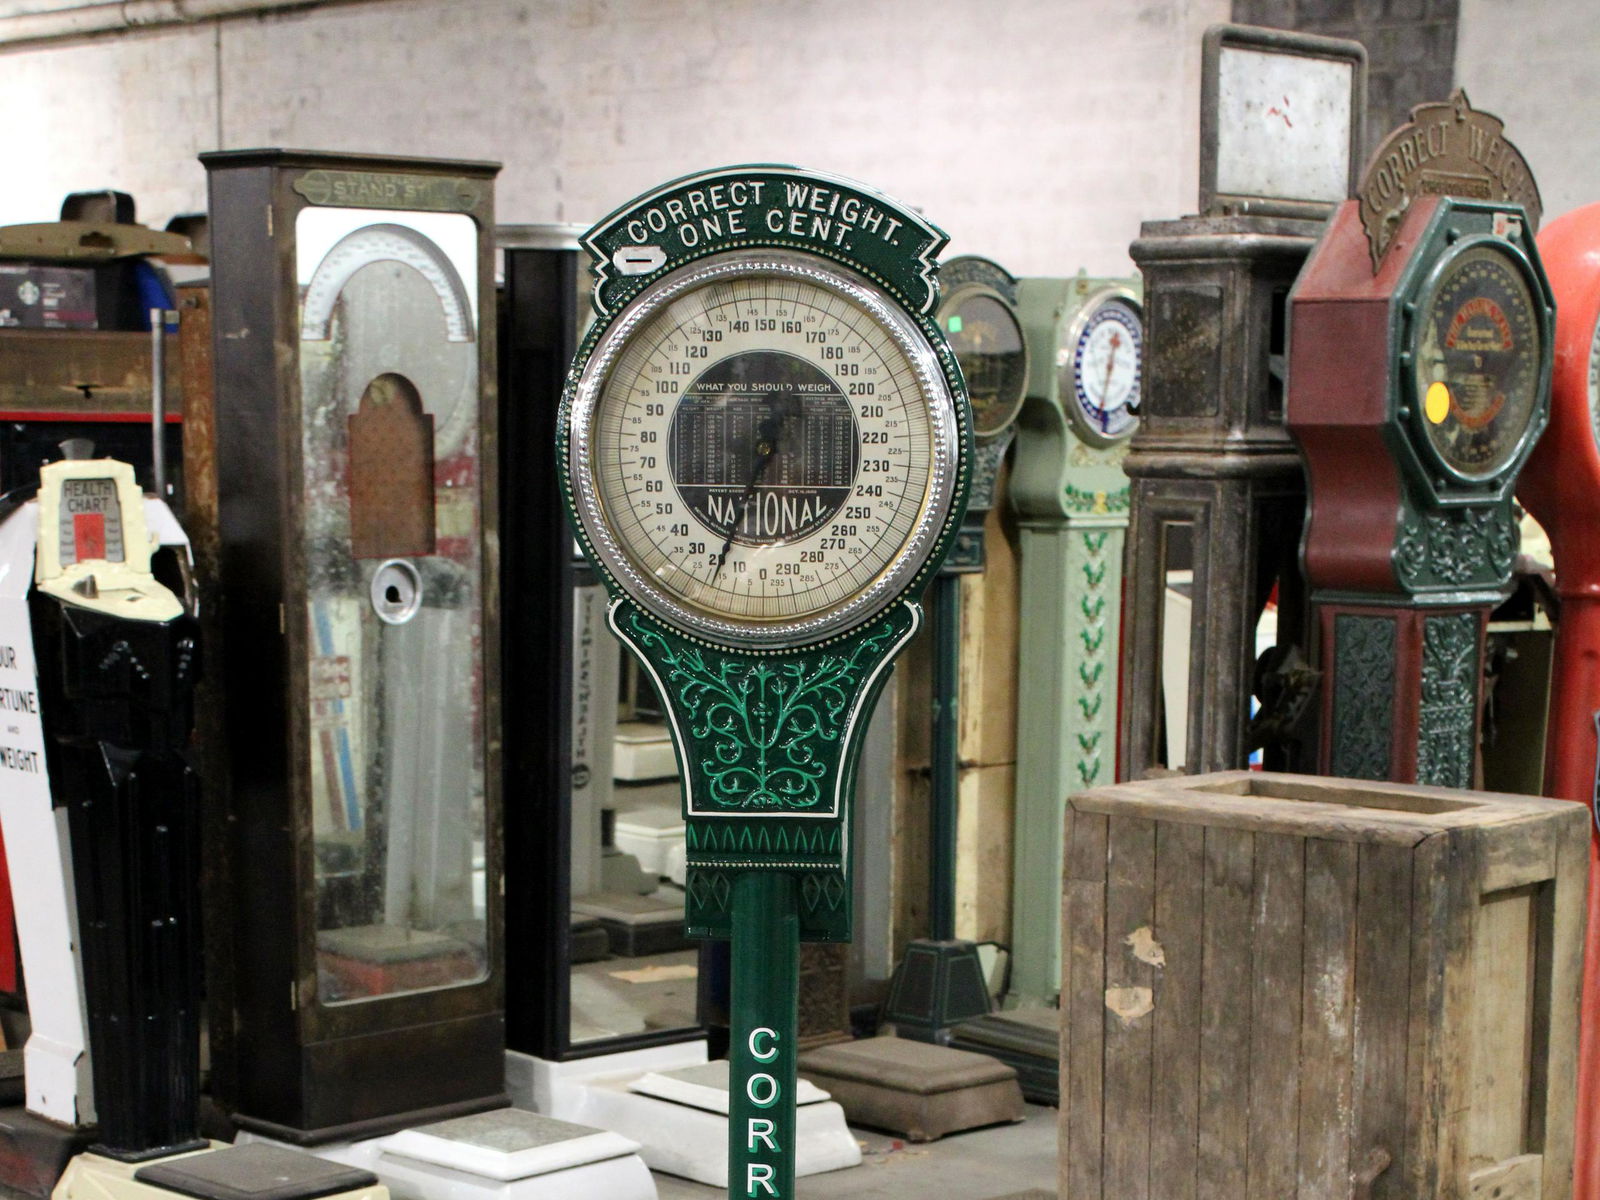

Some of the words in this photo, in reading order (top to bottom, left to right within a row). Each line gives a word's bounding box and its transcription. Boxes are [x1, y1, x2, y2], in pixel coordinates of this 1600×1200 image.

[1368, 121, 1449, 213] CORRECT
[333, 181, 397, 198] STAND
[627, 181, 765, 244] CORRECT
[786, 181, 902, 246] WEIGHT.
[680, 210, 747, 248] ONE
[766, 210, 853, 251] CENT.
[715, 314, 727, 323] 135
[776, 309, 788, 317] 155
[803, 315, 816, 323] 165
[728, 320, 750, 334] 140
[754, 318, 776, 331] 150
[781, 320, 802, 334] 160
[690, 327, 702, 335] 125
[702, 330, 723, 343] 130
[805, 331, 827, 343] 170
[827, 328, 840, 336] 175
[668, 344, 678, 352] 115
[685, 345, 707, 359] 120
[820, 346, 843, 359] 180
[848, 346, 861, 354] 185
[651, 365, 663, 373] 105
[669, 362, 691, 375] 110
[834, 363, 859, 376] 190
[864, 367, 877, 375] 195
[656, 380, 678, 394] 100
[697, 383, 724, 392] WHAT
[727, 383, 747, 392] YOU
[797, 383, 832, 392] WEIGH
[849, 383, 874, 396] 200
[646, 404, 664, 416] 90
[861, 405, 883, 418] 210
[885, 420, 898, 428] 215
[641, 431, 657, 443] 80
[862, 432, 888, 444] 220
[888, 447, 902, 455] 225
[640, 457, 656, 469] 70
[863, 460, 889, 472] 230
[633, 473, 643, 481] 65
[63, 481, 113, 498] HEALTH
[645, 481, 663, 493] 60
[856, 484, 882, 497] 240
[67, 497, 109, 512] CHART
[641, 500, 651, 508] 55
[656, 503, 673, 515] 50
[878, 500, 894, 508] 245
[708, 492, 827, 536] NATIONAL
[845, 507, 871, 520] 250
[670, 524, 688, 536] 40
[831, 525, 857, 537] 260
[866, 525, 880, 533] 255
[689, 542, 705, 554] 30
[821, 538, 846, 550] 270
[800, 551, 824, 563] 280
[733, 561, 746, 573] 10
[776, 563, 800, 575] 290
[824, 562, 839, 570] 275
[759, 568, 767, 580] 0
[800, 574, 815, 583] 285
[770, 579, 785, 587] 295
